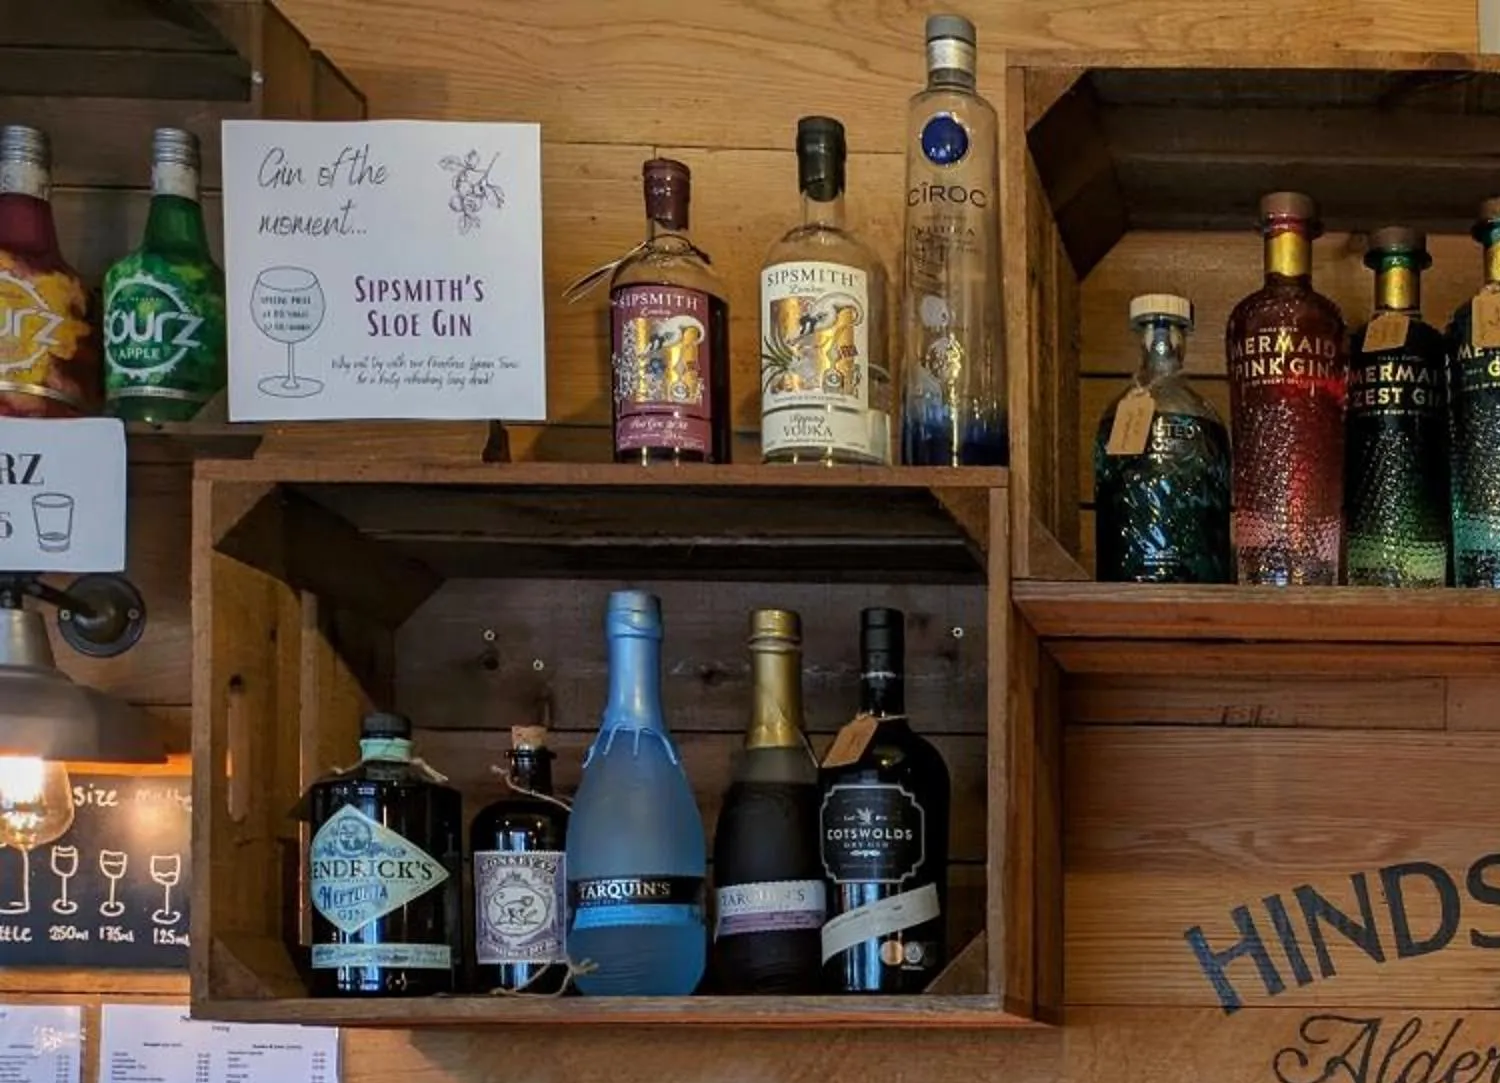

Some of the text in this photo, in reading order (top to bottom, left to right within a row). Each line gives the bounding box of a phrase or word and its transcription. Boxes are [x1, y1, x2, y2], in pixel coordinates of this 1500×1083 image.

[256, 144, 389, 188] Gin of the
[258, 198, 368, 237] moment...
[355, 274, 484, 303] SIPSMITH'S
[767, 267, 855, 288] SIPSMITH
[367, 308, 473, 337] SLOE GIN
[118, 347, 161, 361] APPLE
[1235, 357, 1332, 381] PINK GIN
[1349, 363, 1438, 385] MERMAI
[72, 783, 120, 807] Size
[827, 827, 913, 841] COTSWOLDS
[313, 858, 433, 881] ENDRICK'S
[579, 881, 672, 900] TARQUIN'S
[0, 925, 33, 942] ttle
[153, 927, 191, 947] 125ml
